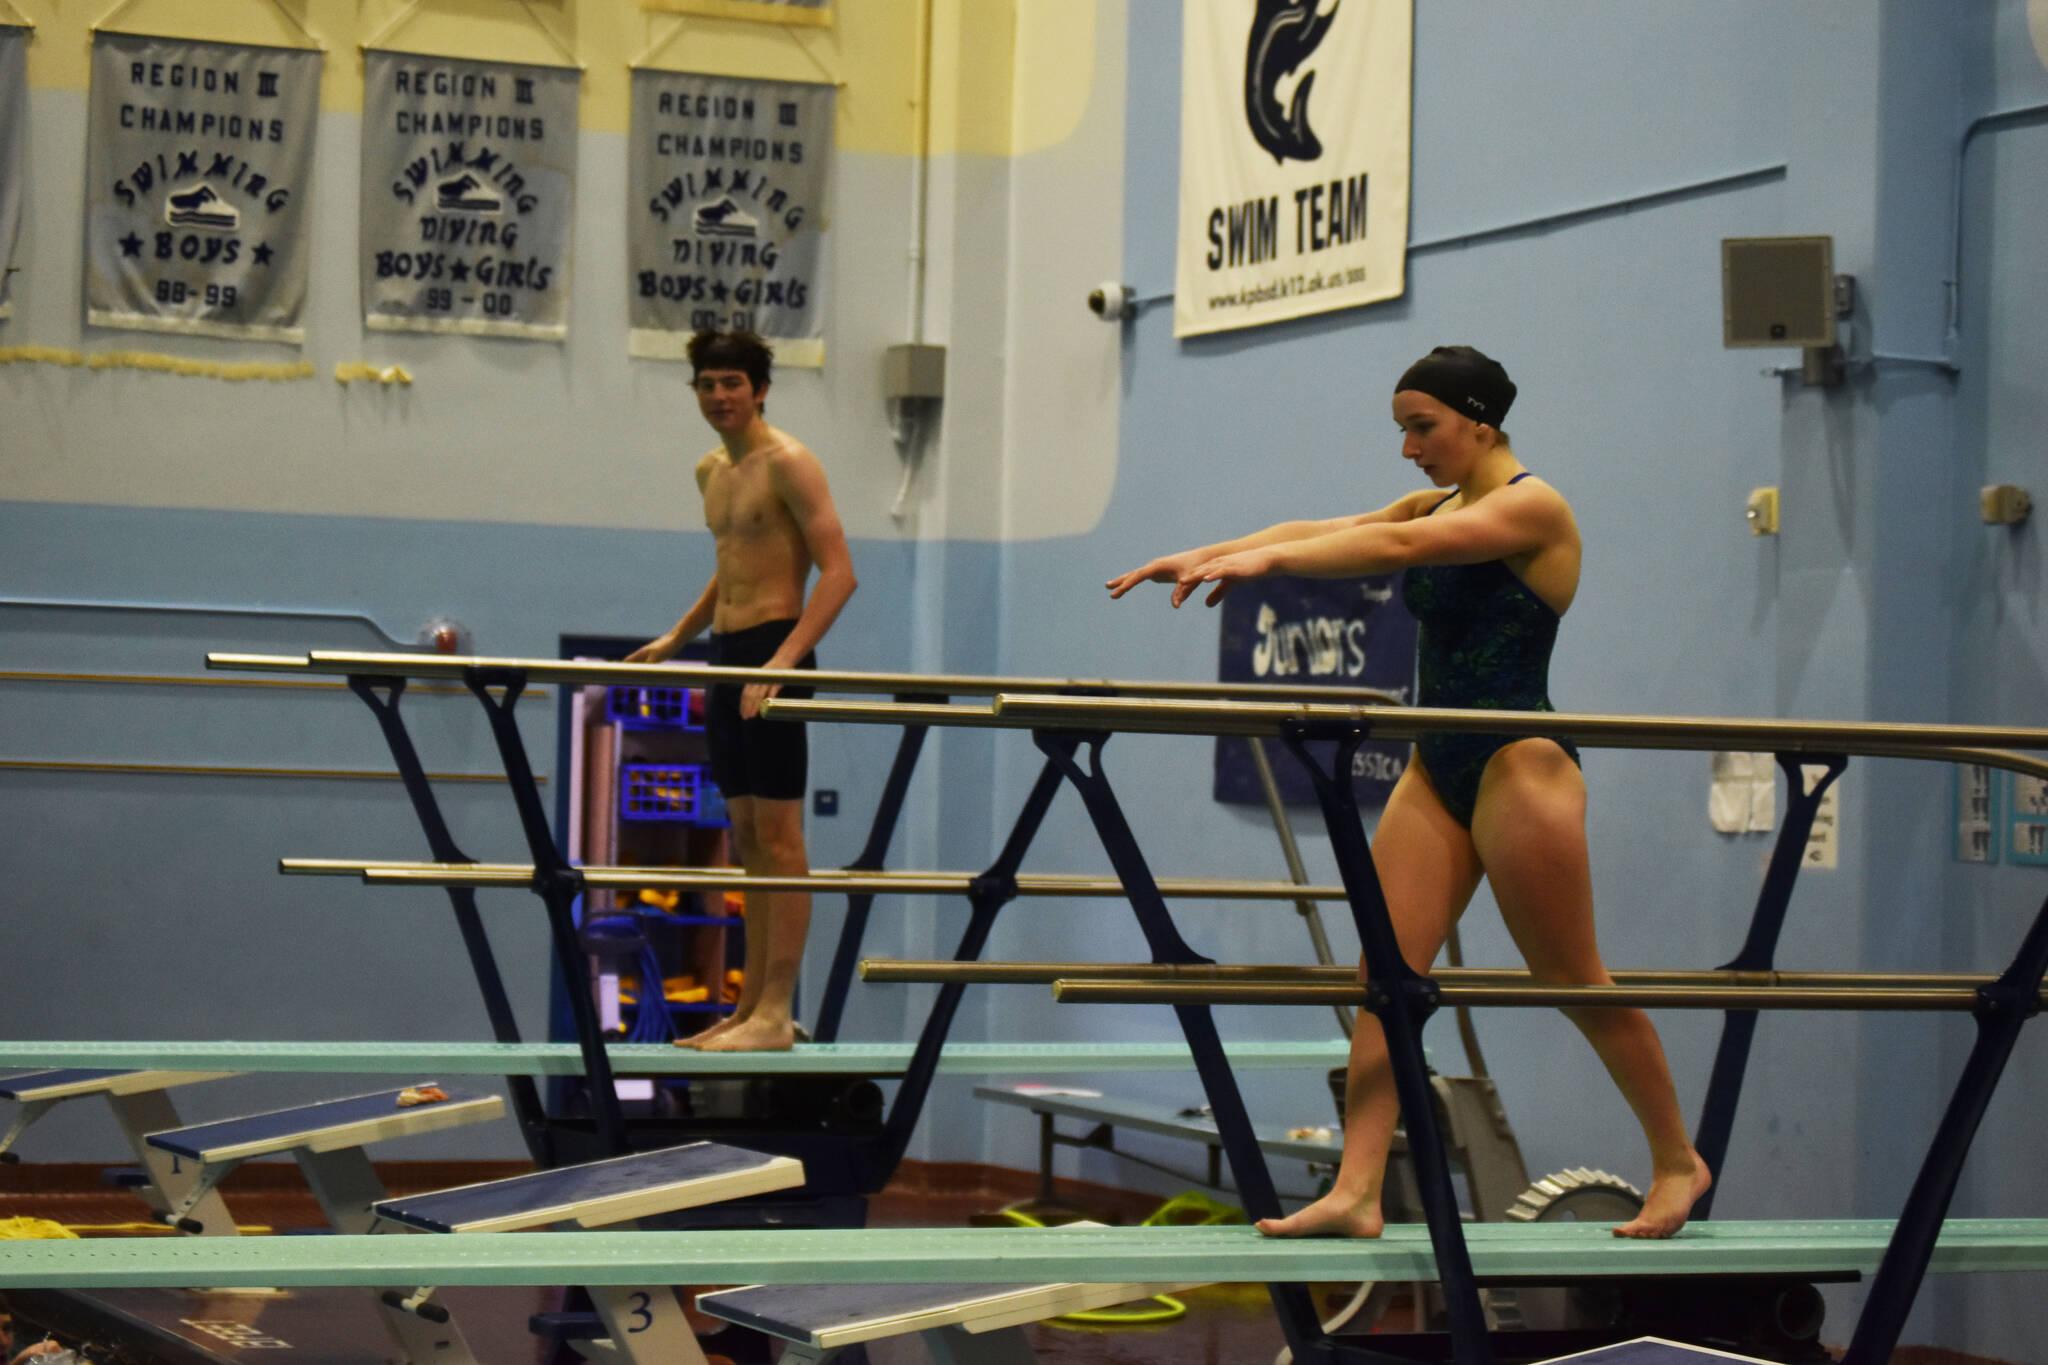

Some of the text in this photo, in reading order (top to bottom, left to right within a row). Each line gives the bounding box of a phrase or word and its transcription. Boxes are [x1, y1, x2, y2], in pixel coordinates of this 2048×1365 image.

[131, 62, 279, 97] REGION III
[395, 71, 535, 105] REGION III
[120, 104, 284, 142] CHAMPIONS
[659, 92, 755, 120] REGION
[397, 111, 545, 140] CHAMPIONS
[657, 133, 804, 164] CHAMPIONS
[113, 150, 290, 213] SWIMMING
[392, 141, 539, 214] SWIMMING
[650, 167, 805, 230] SWIMMING
[1207, 172, 1368, 271] SWIM TEAM
[627, 1291, 653, 1334] 3
